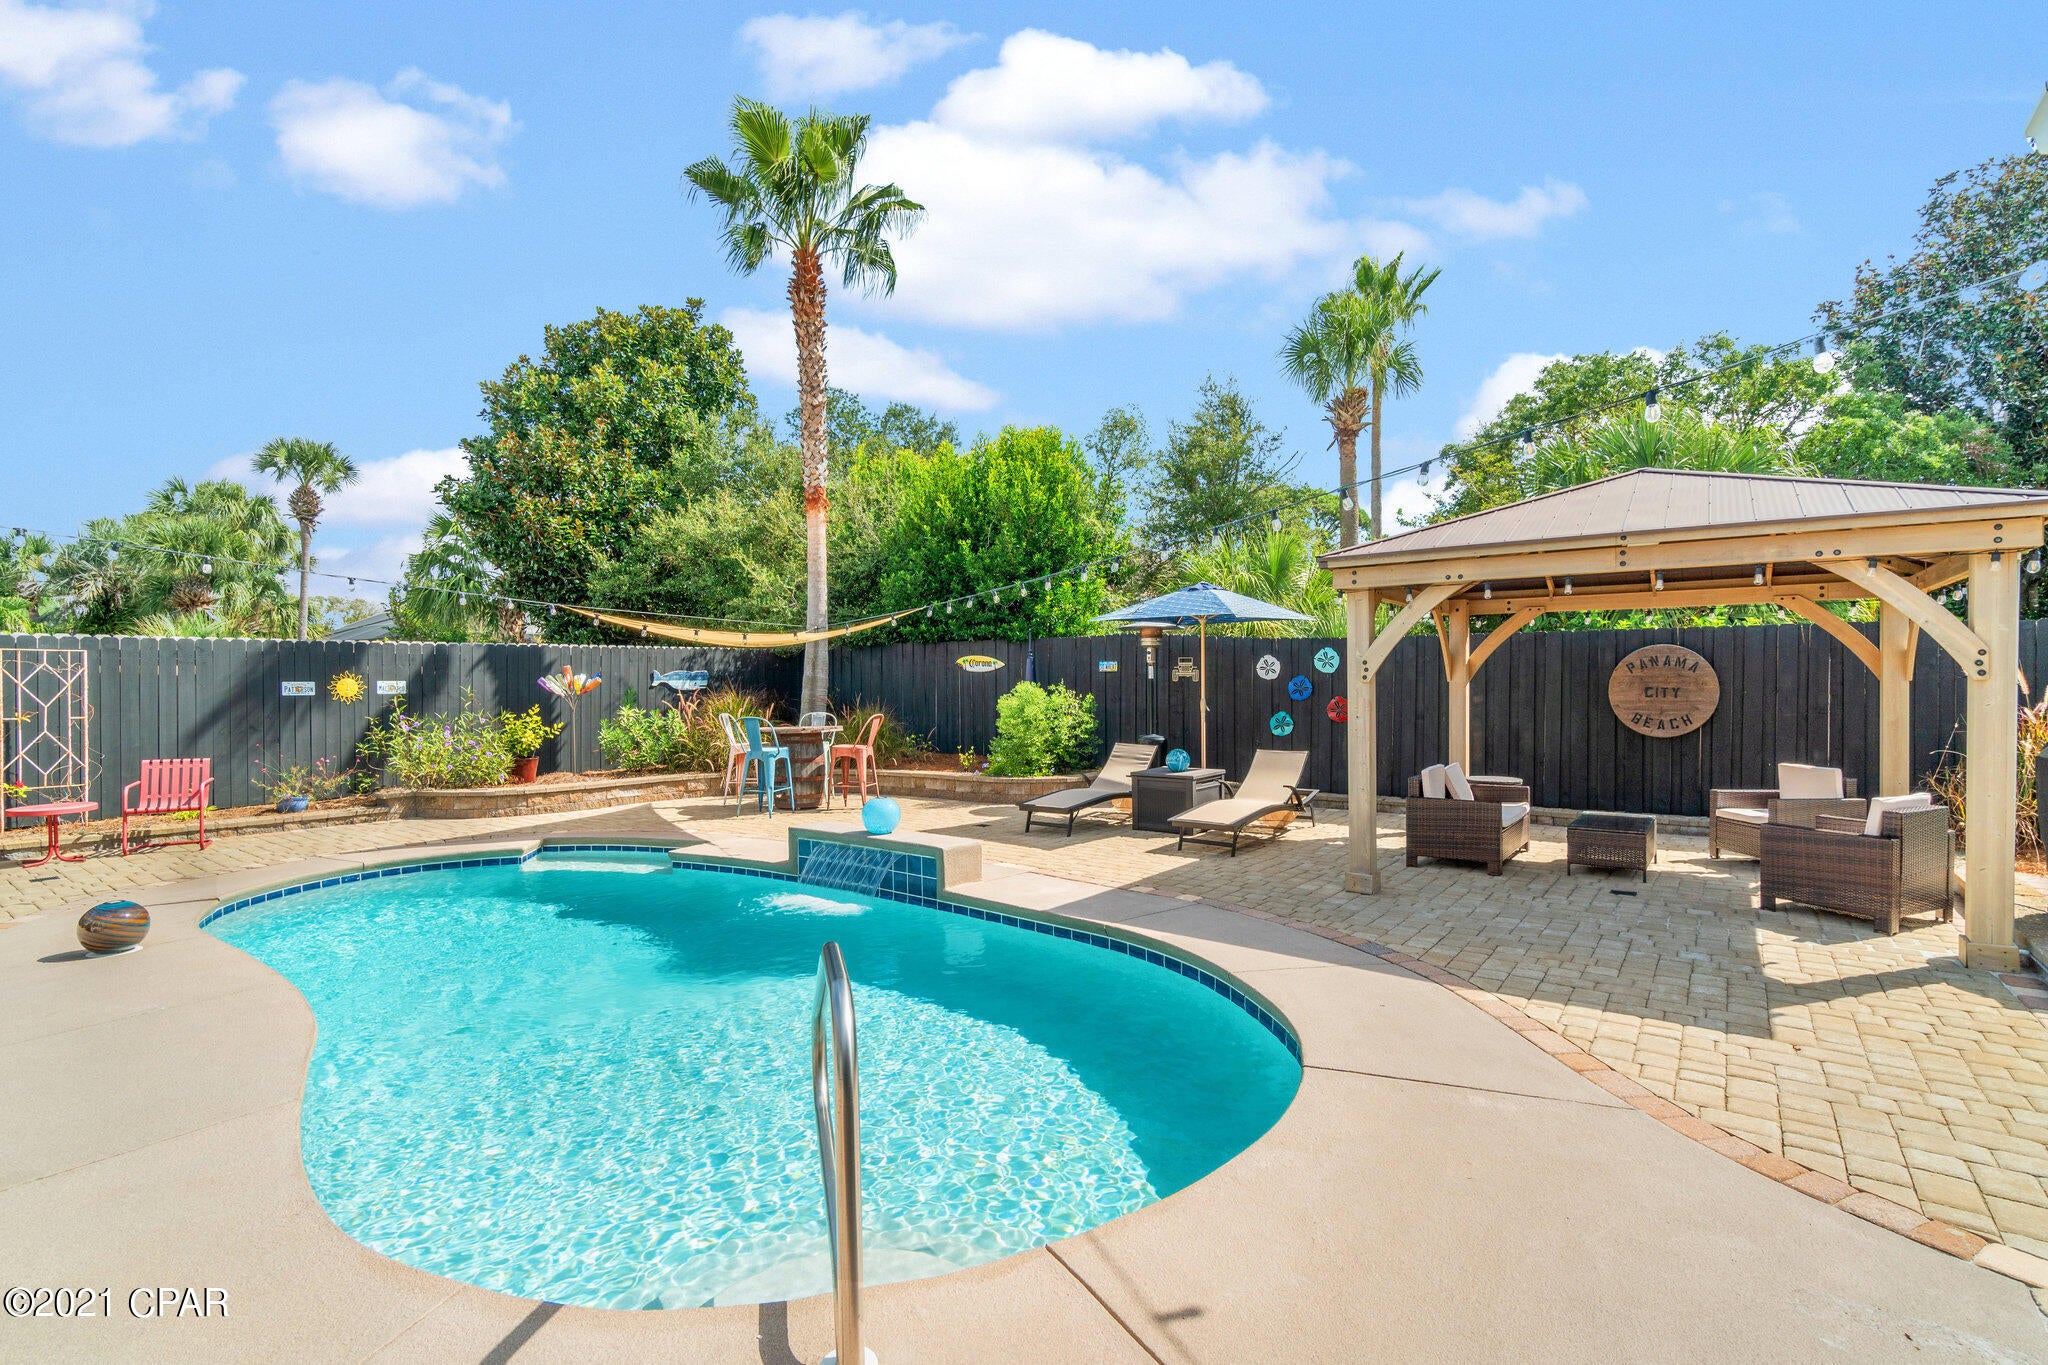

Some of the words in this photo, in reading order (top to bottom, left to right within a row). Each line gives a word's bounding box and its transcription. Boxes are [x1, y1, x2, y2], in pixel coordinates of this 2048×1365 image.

[969, 659, 992, 668] Corona
[1626, 655, 1699, 673] PANAMA
[1645, 687, 1680, 698] CITY
[1631, 712, 1693, 730] BEACH
